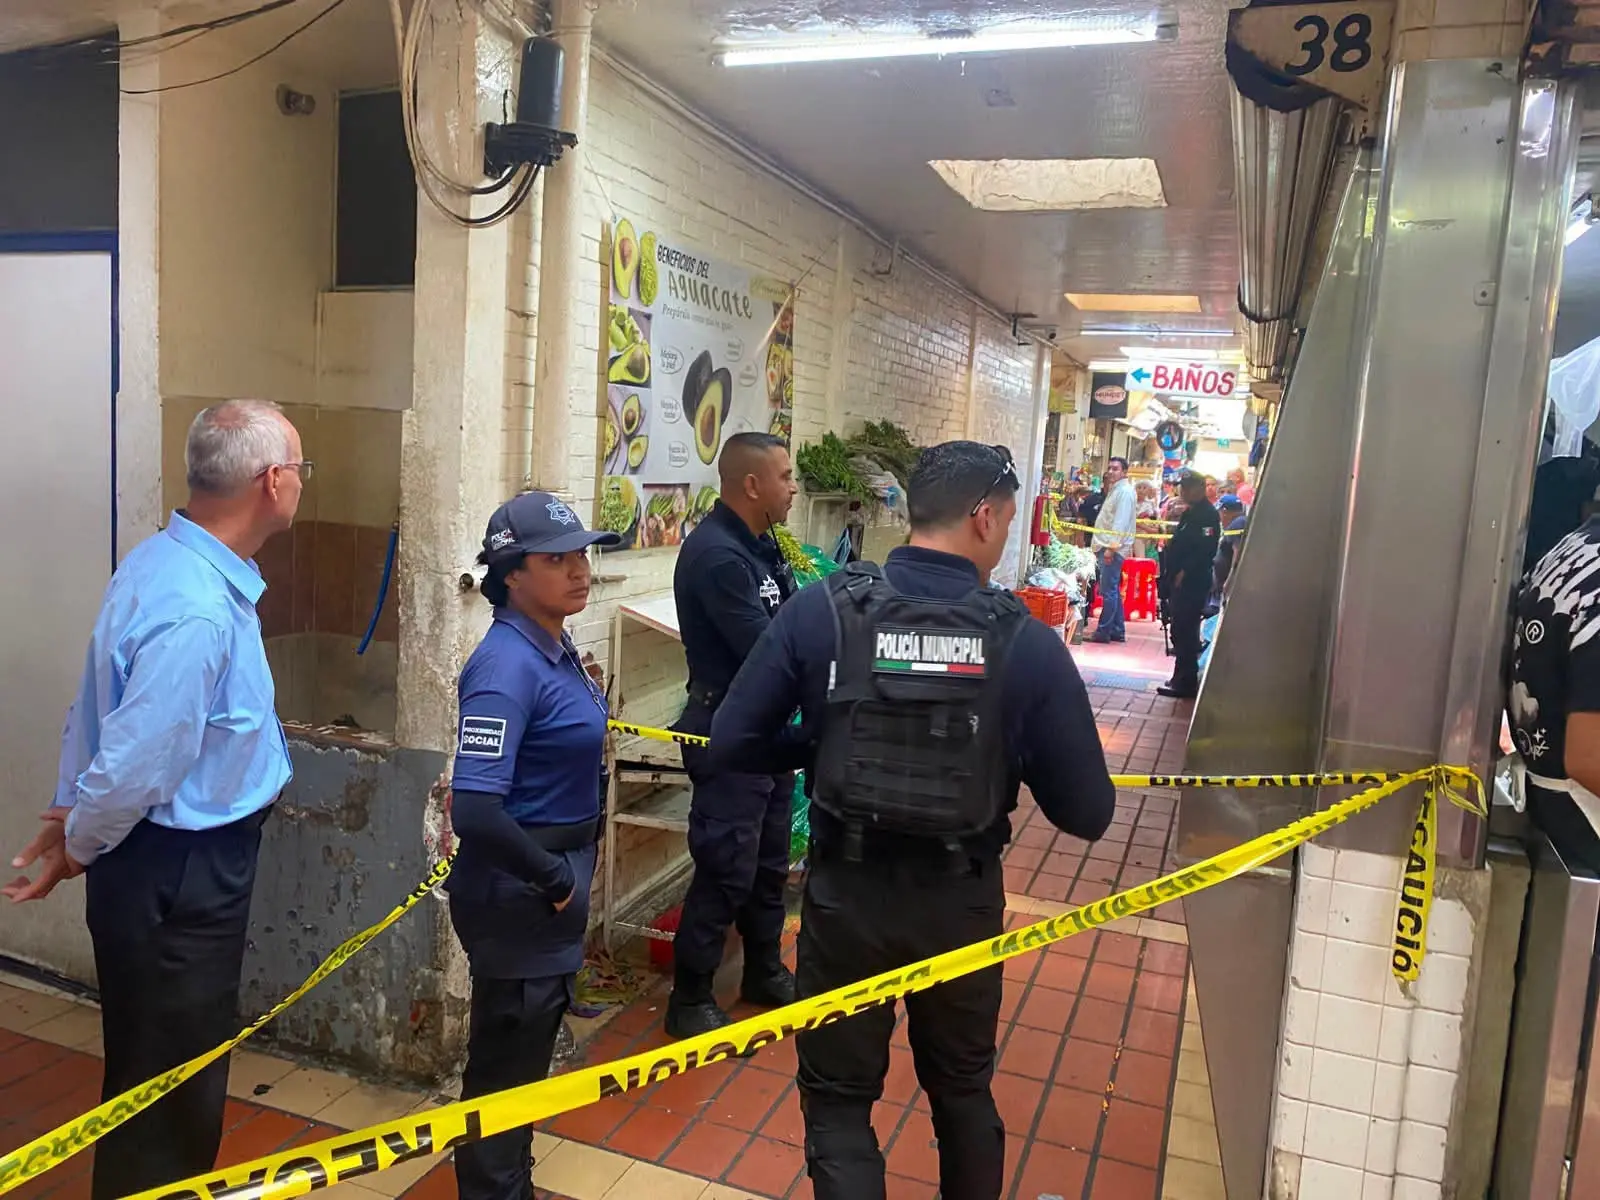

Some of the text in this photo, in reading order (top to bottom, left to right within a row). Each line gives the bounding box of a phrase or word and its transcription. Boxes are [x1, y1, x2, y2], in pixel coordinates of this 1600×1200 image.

[1284, 13, 1371, 75] 38
[657, 244, 710, 278] BENEFICIOS DEL
[668, 270, 752, 319] Aguacate
[1152, 363, 1235, 396] BAÑOS
[876, 631, 985, 664] POLICÍA MUNICIPAL
[463, 735, 501, 747] SOCIAL
